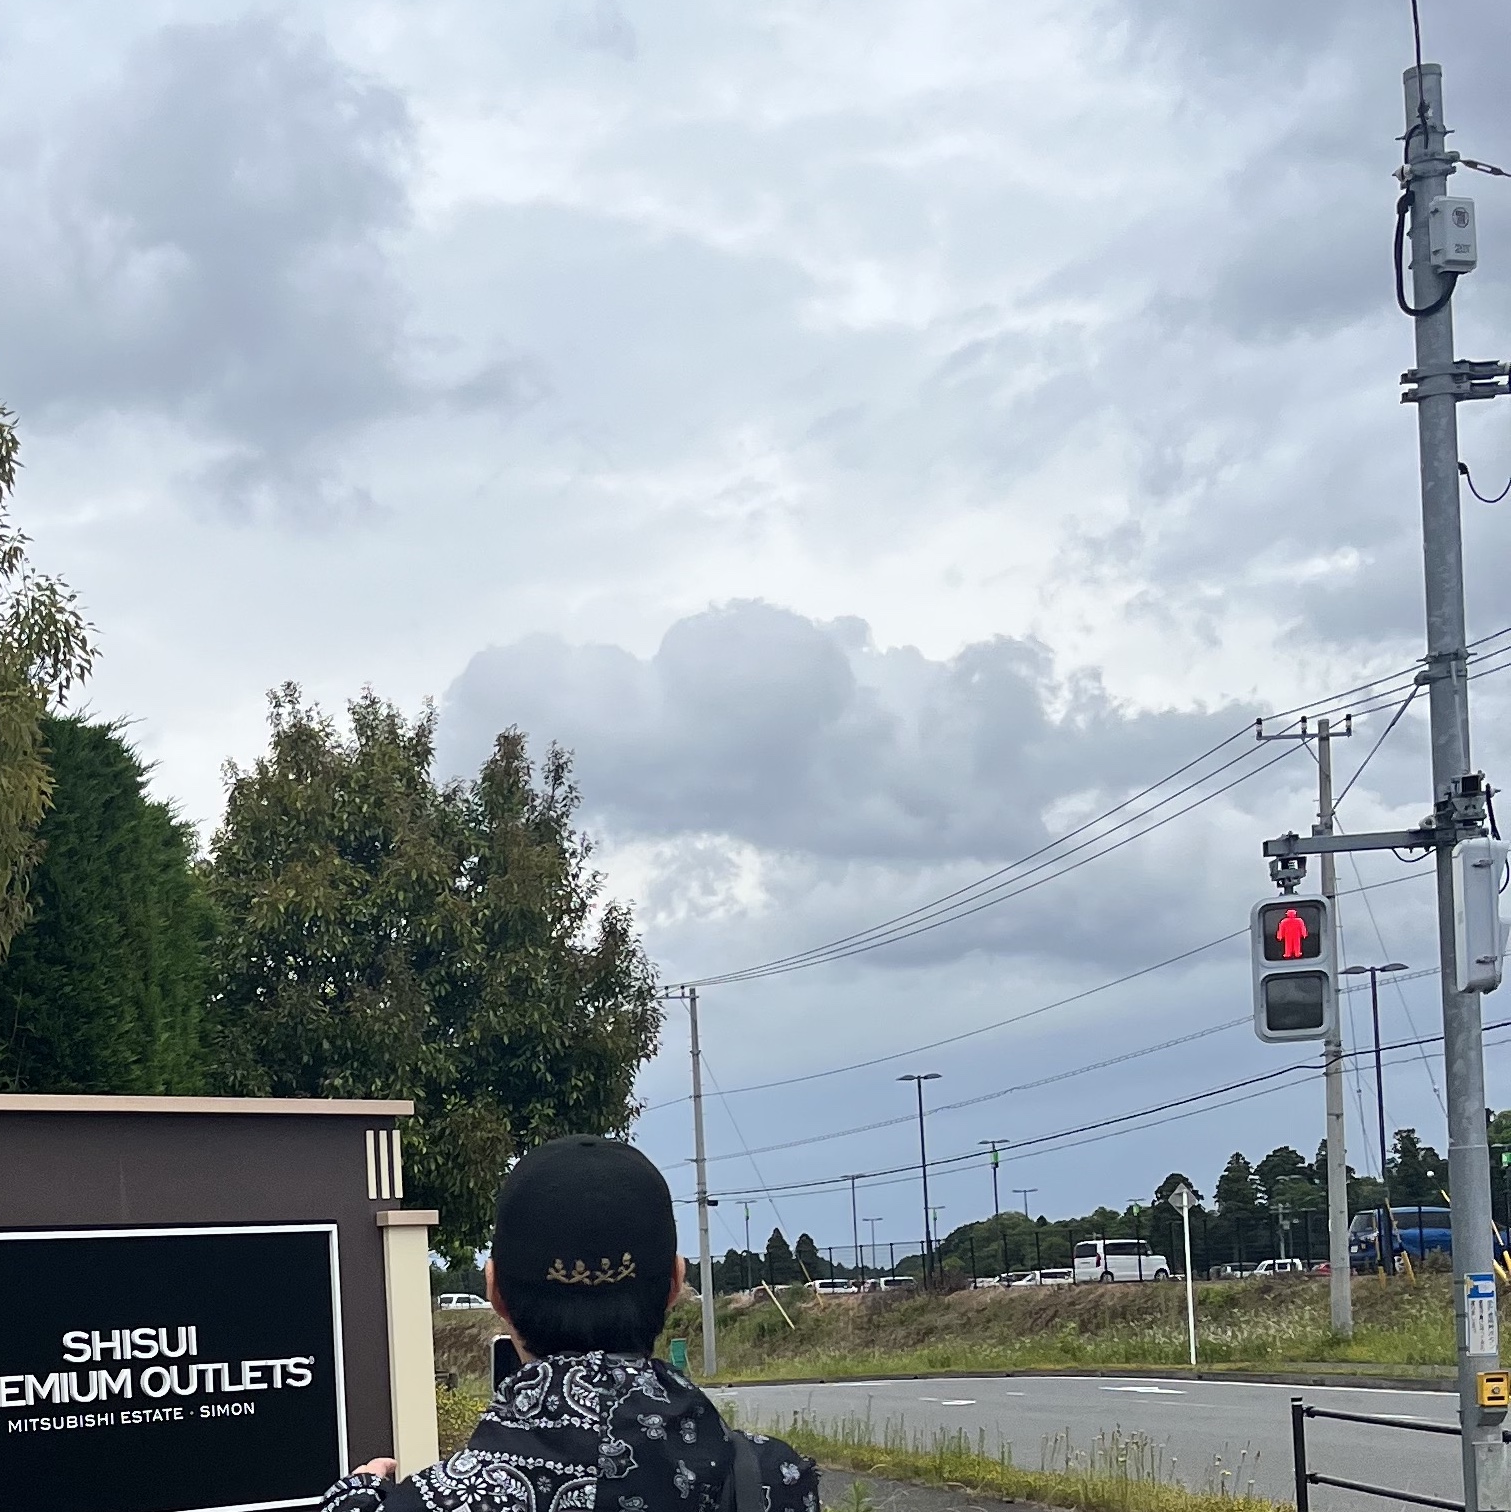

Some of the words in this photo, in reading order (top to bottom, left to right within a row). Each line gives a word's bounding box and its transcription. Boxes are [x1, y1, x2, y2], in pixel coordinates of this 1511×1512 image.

[63, 1326, 197, 1362] SHISUI
[8, 1413, 115, 1433] MITSUBISHI
[121, 1408, 184, 1424] ESTATE
[200, 1402, 255, 1418] SIMON
